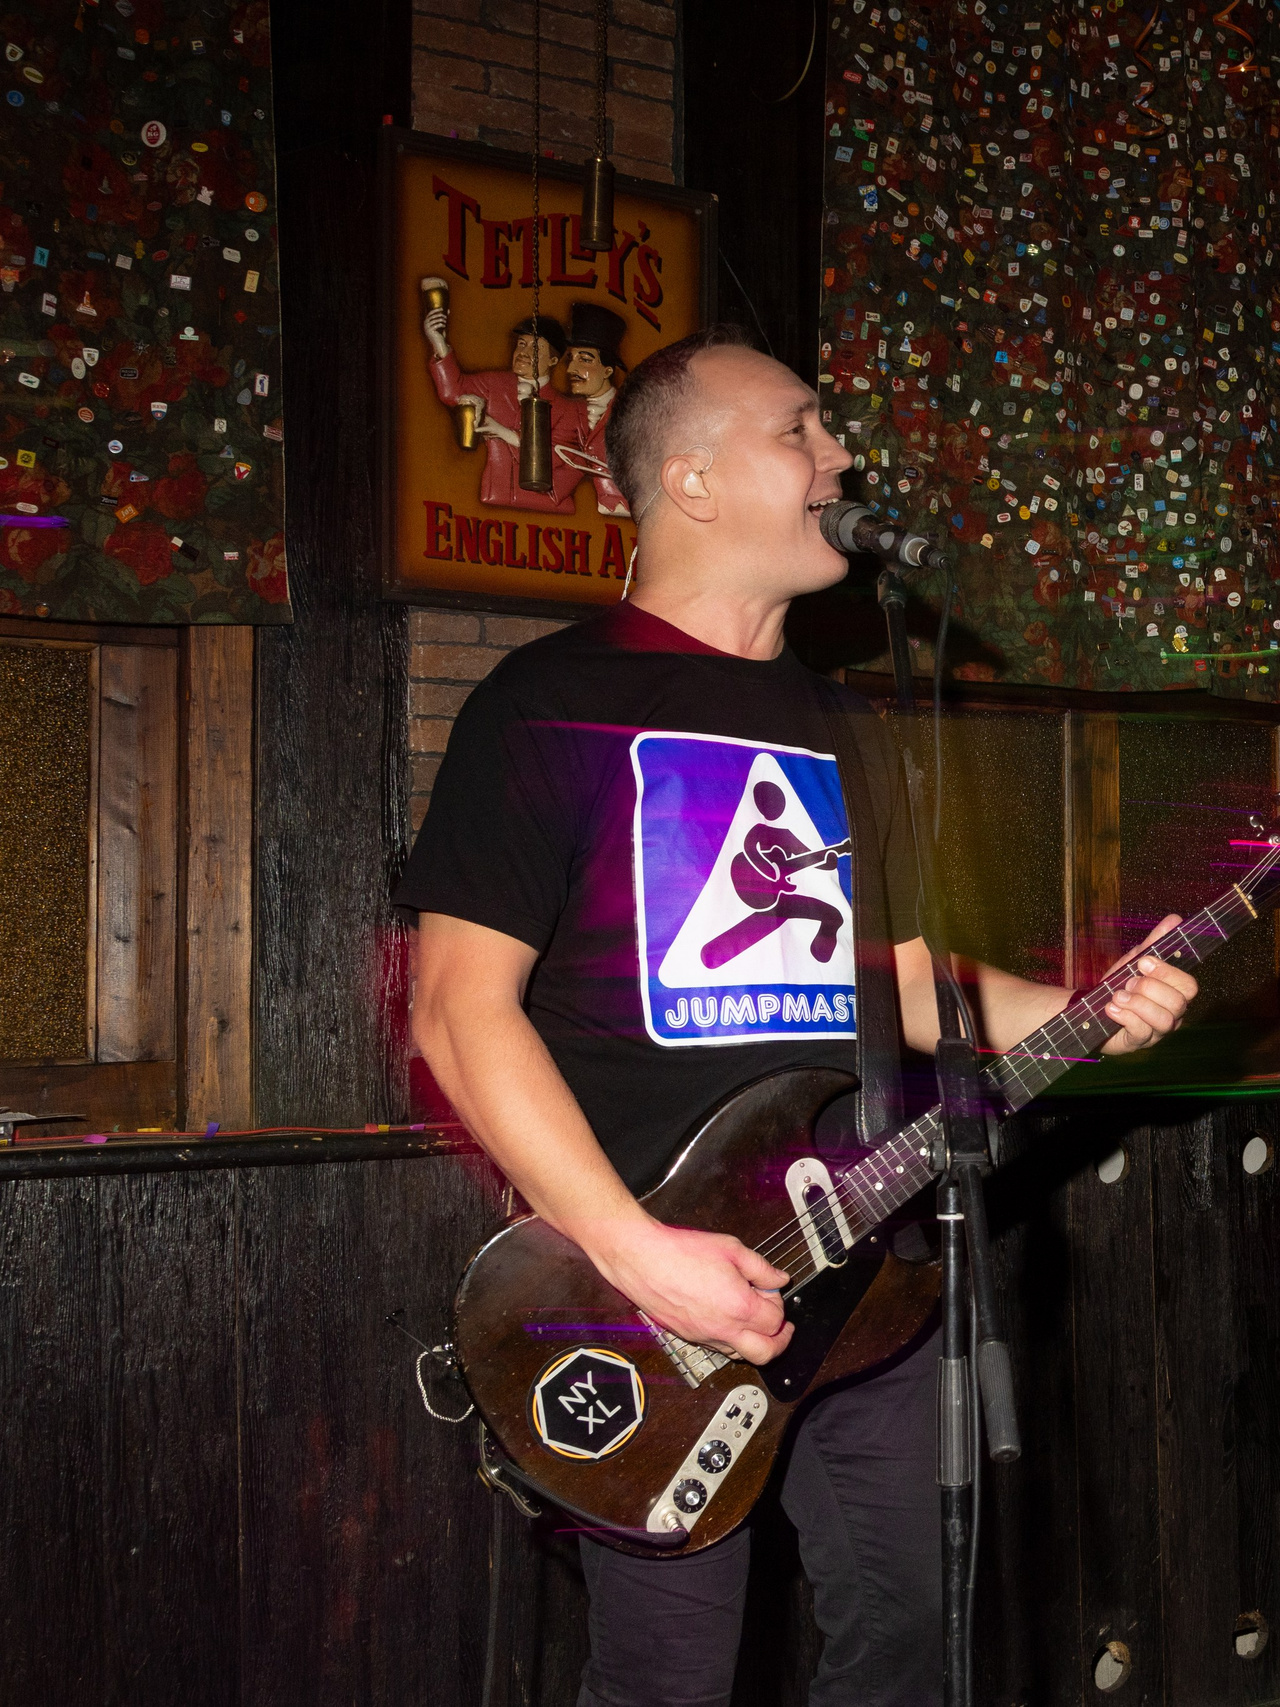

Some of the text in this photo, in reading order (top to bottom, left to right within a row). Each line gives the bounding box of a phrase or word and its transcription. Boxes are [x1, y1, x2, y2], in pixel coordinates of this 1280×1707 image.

[423, 500, 637, 582] ENGLISH A
[558, 1371, 598, 1414] NY
[576, 1400, 622, 1435] XL
